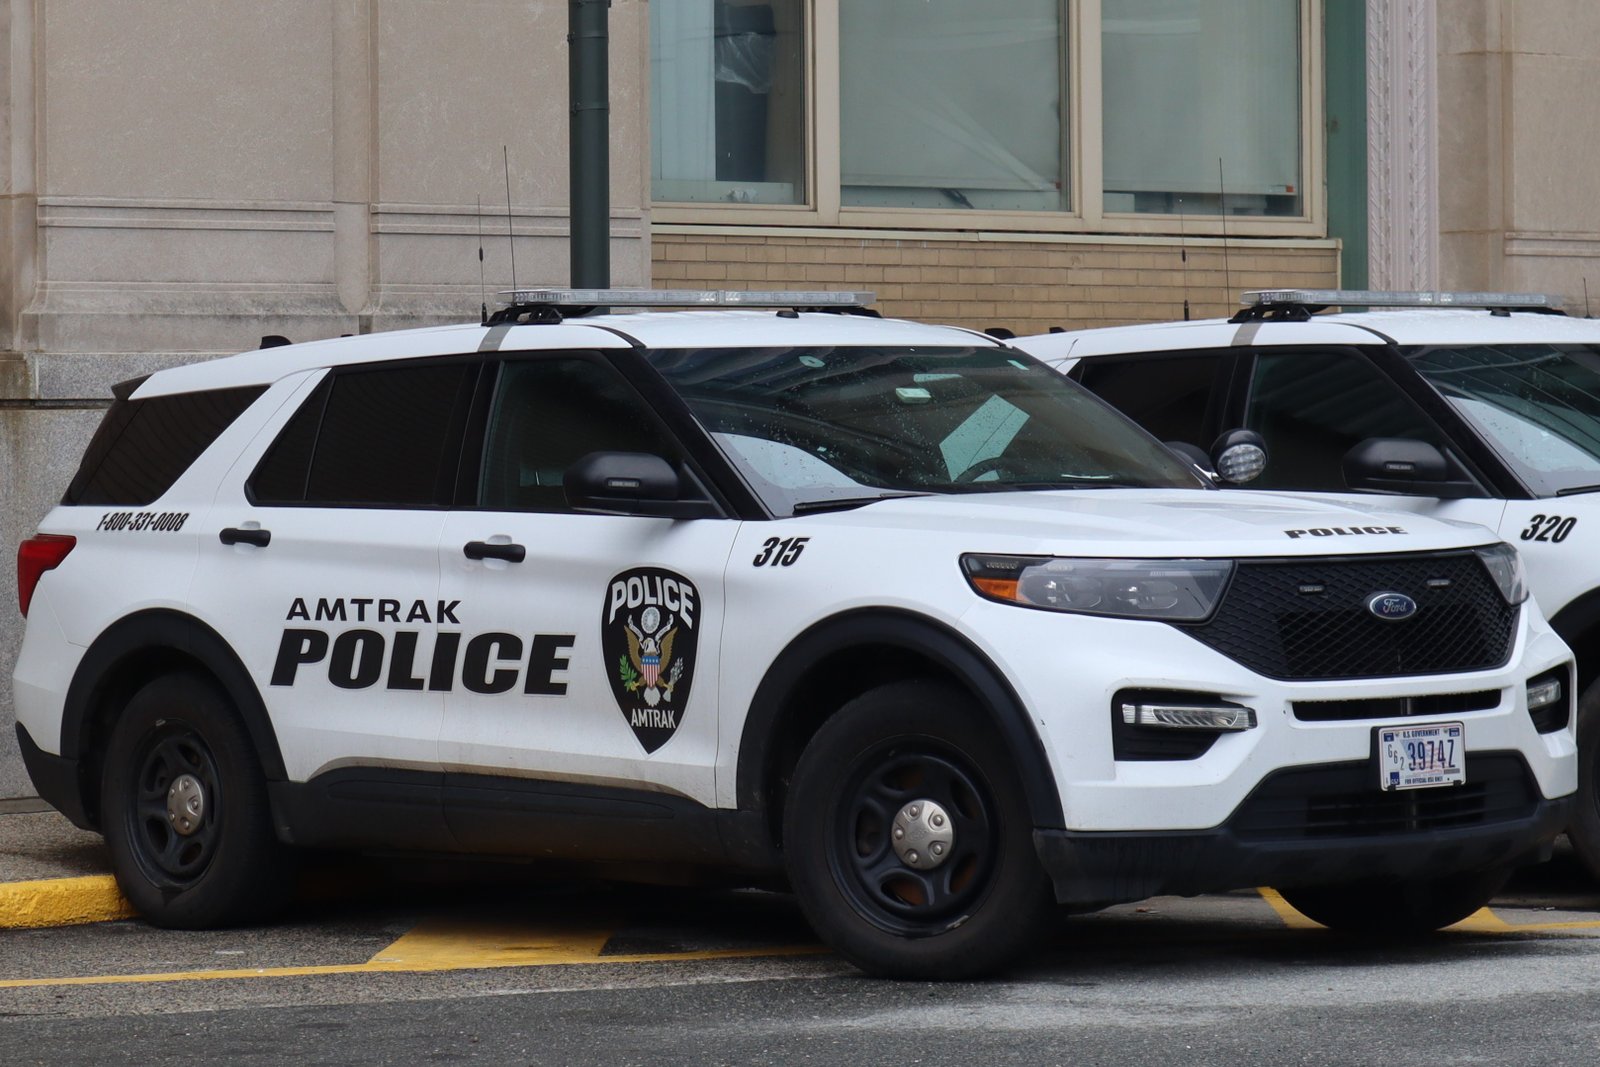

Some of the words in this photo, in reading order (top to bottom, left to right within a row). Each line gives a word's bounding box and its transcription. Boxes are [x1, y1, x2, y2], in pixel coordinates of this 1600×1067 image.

[96, 512, 190, 531] 1-800-331-0008
[1284, 526, 1409, 539] POLICE
[1520, 514, 1577, 543] 320
[753, 537, 811, 567] 315
[286, 597, 461, 624] AMTRAK
[609, 575, 694, 629] POLICE
[1383, 598, 1407, 613] Ford
[270, 628, 576, 695] POLICE
[631, 708, 676, 729] AMTRAK
[1408, 739, 1456, 771] 3974Z
